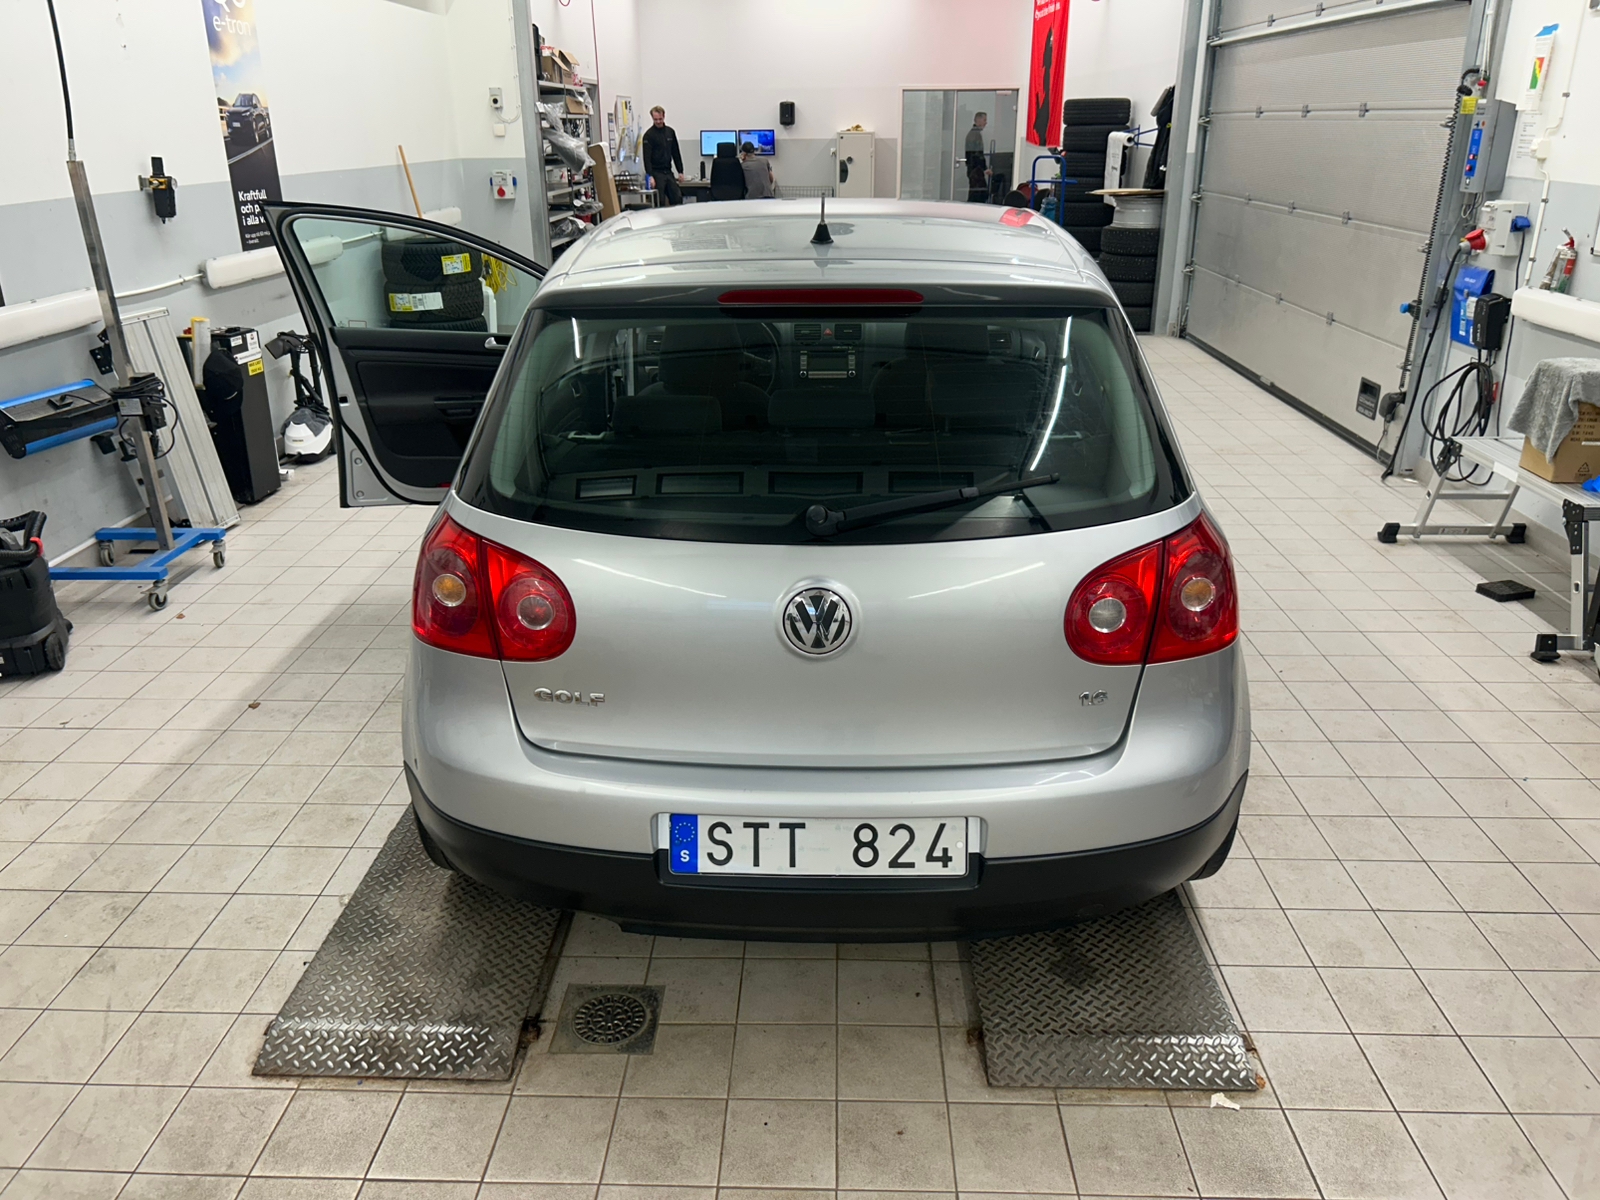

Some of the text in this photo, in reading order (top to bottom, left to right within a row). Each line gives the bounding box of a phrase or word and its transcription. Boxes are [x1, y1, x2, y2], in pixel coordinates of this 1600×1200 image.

[212, 15, 252, 36] e-tron
[238, 189, 267, 201] Kraftfull
[240, 203, 253, 214] och
[242, 215, 246, 226] i
[246, 214, 259, 225] alla
[533, 686, 606, 707] GOLF
[706, 821, 953, 869] STT 824
[680, 849, 690, 863] S
